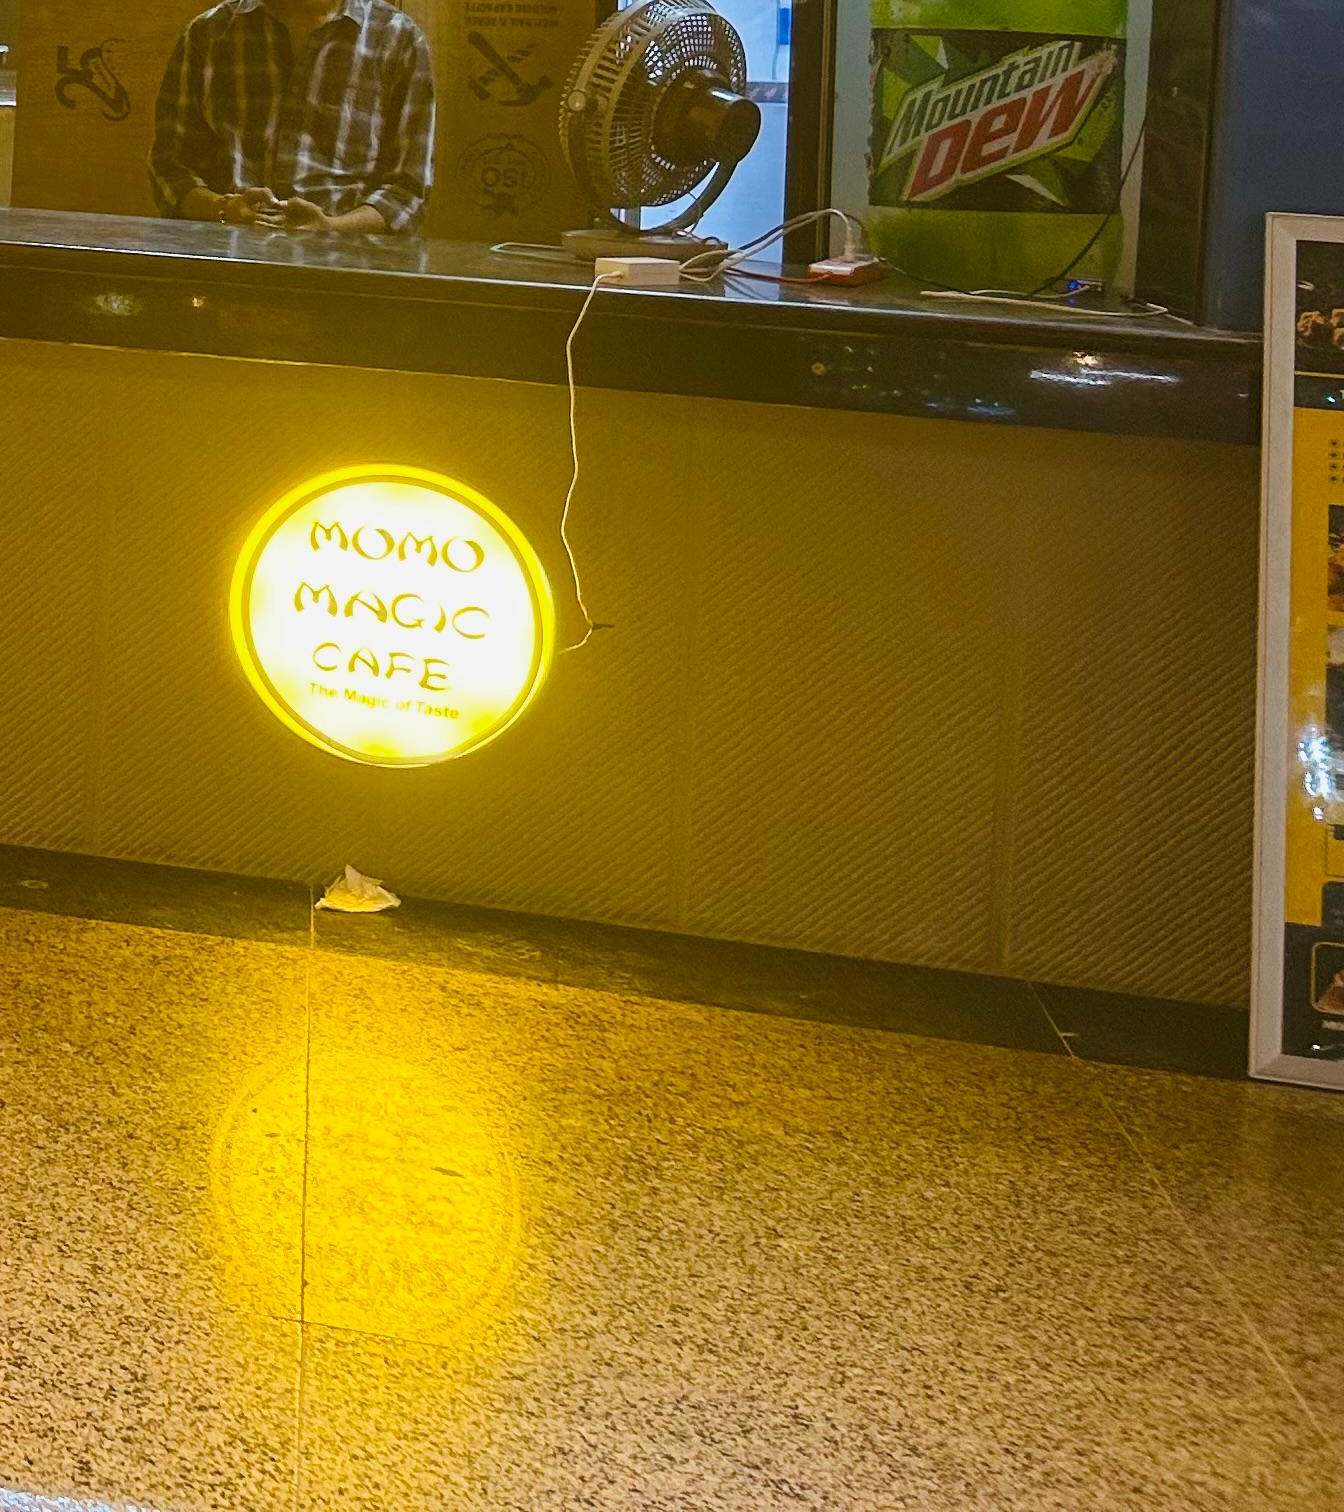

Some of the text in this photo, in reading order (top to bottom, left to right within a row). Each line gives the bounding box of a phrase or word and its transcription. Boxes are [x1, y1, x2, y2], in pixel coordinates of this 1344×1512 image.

[894, 41, 1077, 150] Mountain
[310, 521, 484, 572] MOMO
[294, 582, 490, 639] MAGIC
[312, 642, 451, 691] CAFE
[310, 682, 461, 720] The Magic of Taste
